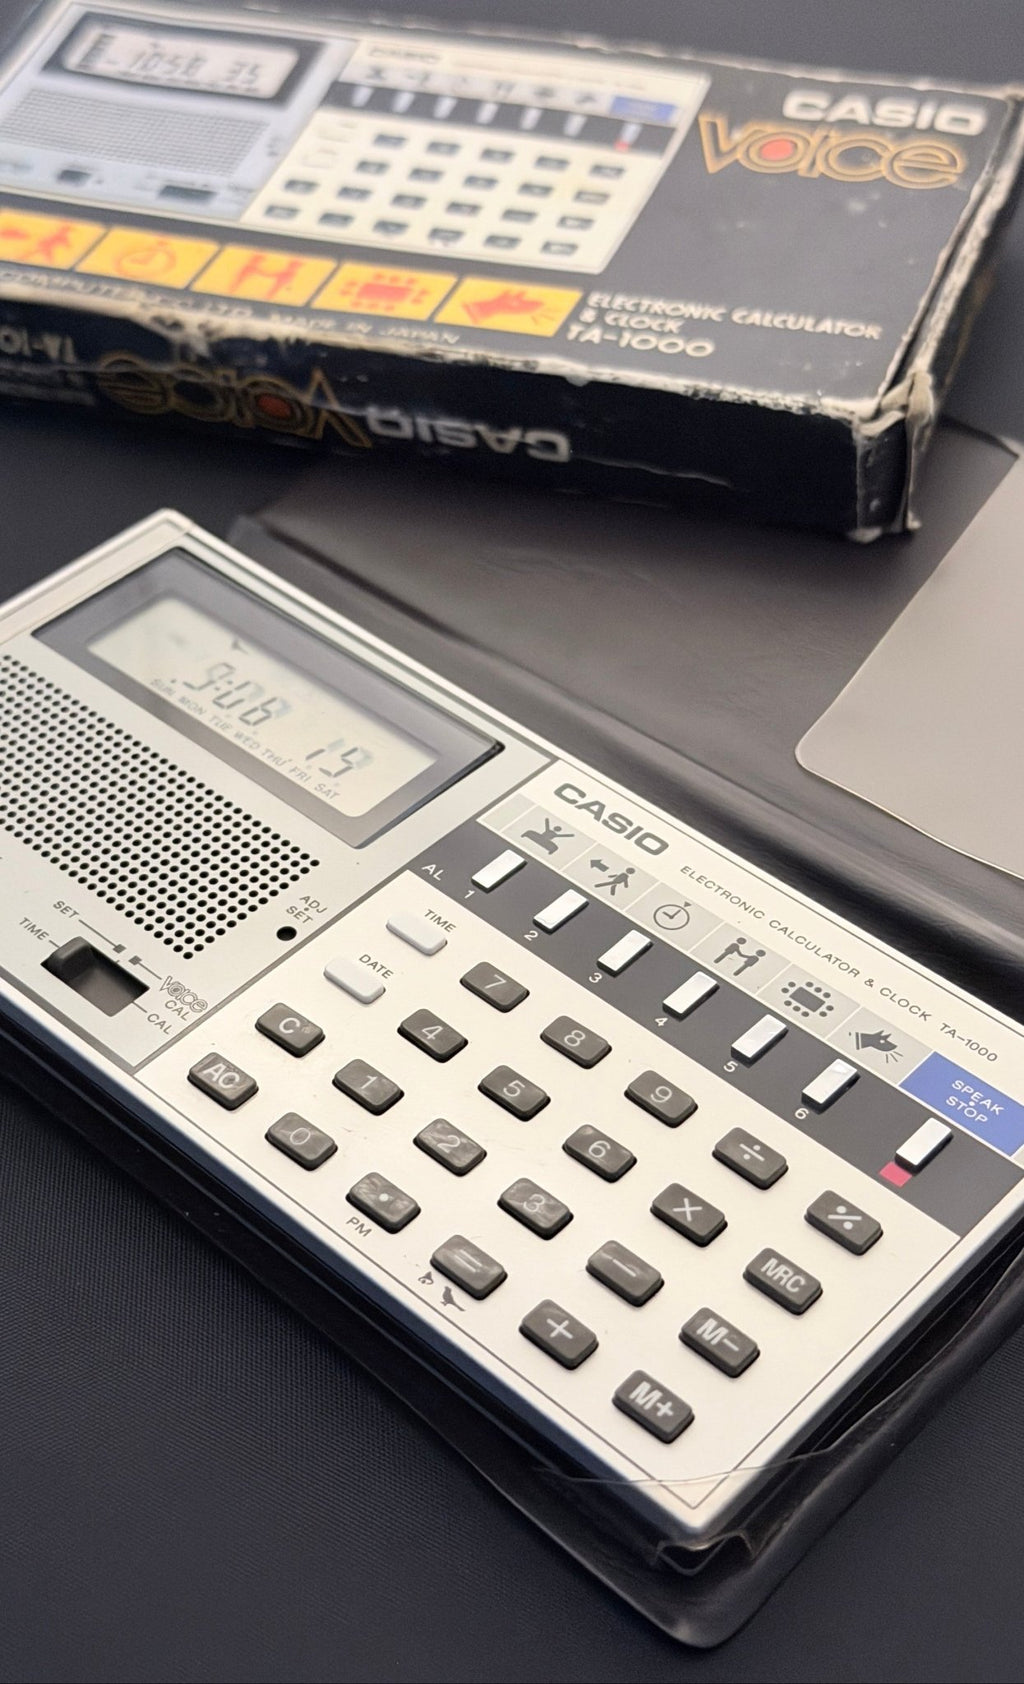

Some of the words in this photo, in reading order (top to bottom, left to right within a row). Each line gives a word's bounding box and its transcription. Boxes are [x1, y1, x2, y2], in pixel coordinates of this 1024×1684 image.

[782, 89, 988, 136] CASIO
[587, 291, 727, 322] ELECTRONIC
[731, 306, 883, 341] CALCULATOR
[603, 309, 686, 335] CLOCK
[347, 321, 372, 334] IN
[379, 324, 460, 345] JAPAN
[565, 323, 715, 357] TA-1000
[365, 404, 570, 462] CASIO
[151, 678, 176, 696] SUN
[178, 695, 206, 716] MON
[234, 731, 260, 750] WED
[262, 748, 288, 767] THU
[289, 765, 312, 783] FRI
[314, 782, 341, 801] SAT
[553, 782, 670, 856] CASIO
[421, 862, 448, 881] AL
[464, 889, 475, 899] 1
[53, 900, 79, 919] SET
[299, 895, 328, 914] ADJ
[286, 905, 313, 925] SET
[423, 909, 457, 933] TIME
[19, 917, 50, 941] TIME
[524, 930, 538, 941] 2
[358, 954, 394, 979] DATE
[680, 865, 765, 919] ELECTRONIC
[768, 919, 860, 978] CALCULATOR
[864, 977, 875, 988] &
[879, 986, 932, 1021] CLOCK
[939, 1021, 998, 1062] TA-1000
[483, 974, 506, 989] 7
[588, 972, 602, 984] 3
[165, 1000, 190, 1021] CAL
[147, 1013, 172, 1035] CAL
[279, 1017, 300, 1034] C
[654, 1016, 668, 1027] 4
[421, 1024, 444, 1040] 4
[563, 1029, 587, 1047] 8
[203, 1063, 241, 1089] AC
[723, 1061, 738, 1073] 5
[360, 1075, 378, 1090] 1
[503, 1080, 526, 1097] 5
[650, 1085, 673, 1103] 9
[952, 1080, 1004, 1115] SPEAK
[795, 1108, 809, 1120] 6
[946, 1096, 988, 1122] STOP
[437, 1135, 461, 1153] 2
[589, 1140, 611, 1158] 6
[522, 1194, 546, 1213] 3
[346, 1216, 372, 1237] PM
[760, 1257, 805, 1294] MRC
[629, 1380, 674, 1418] M+
